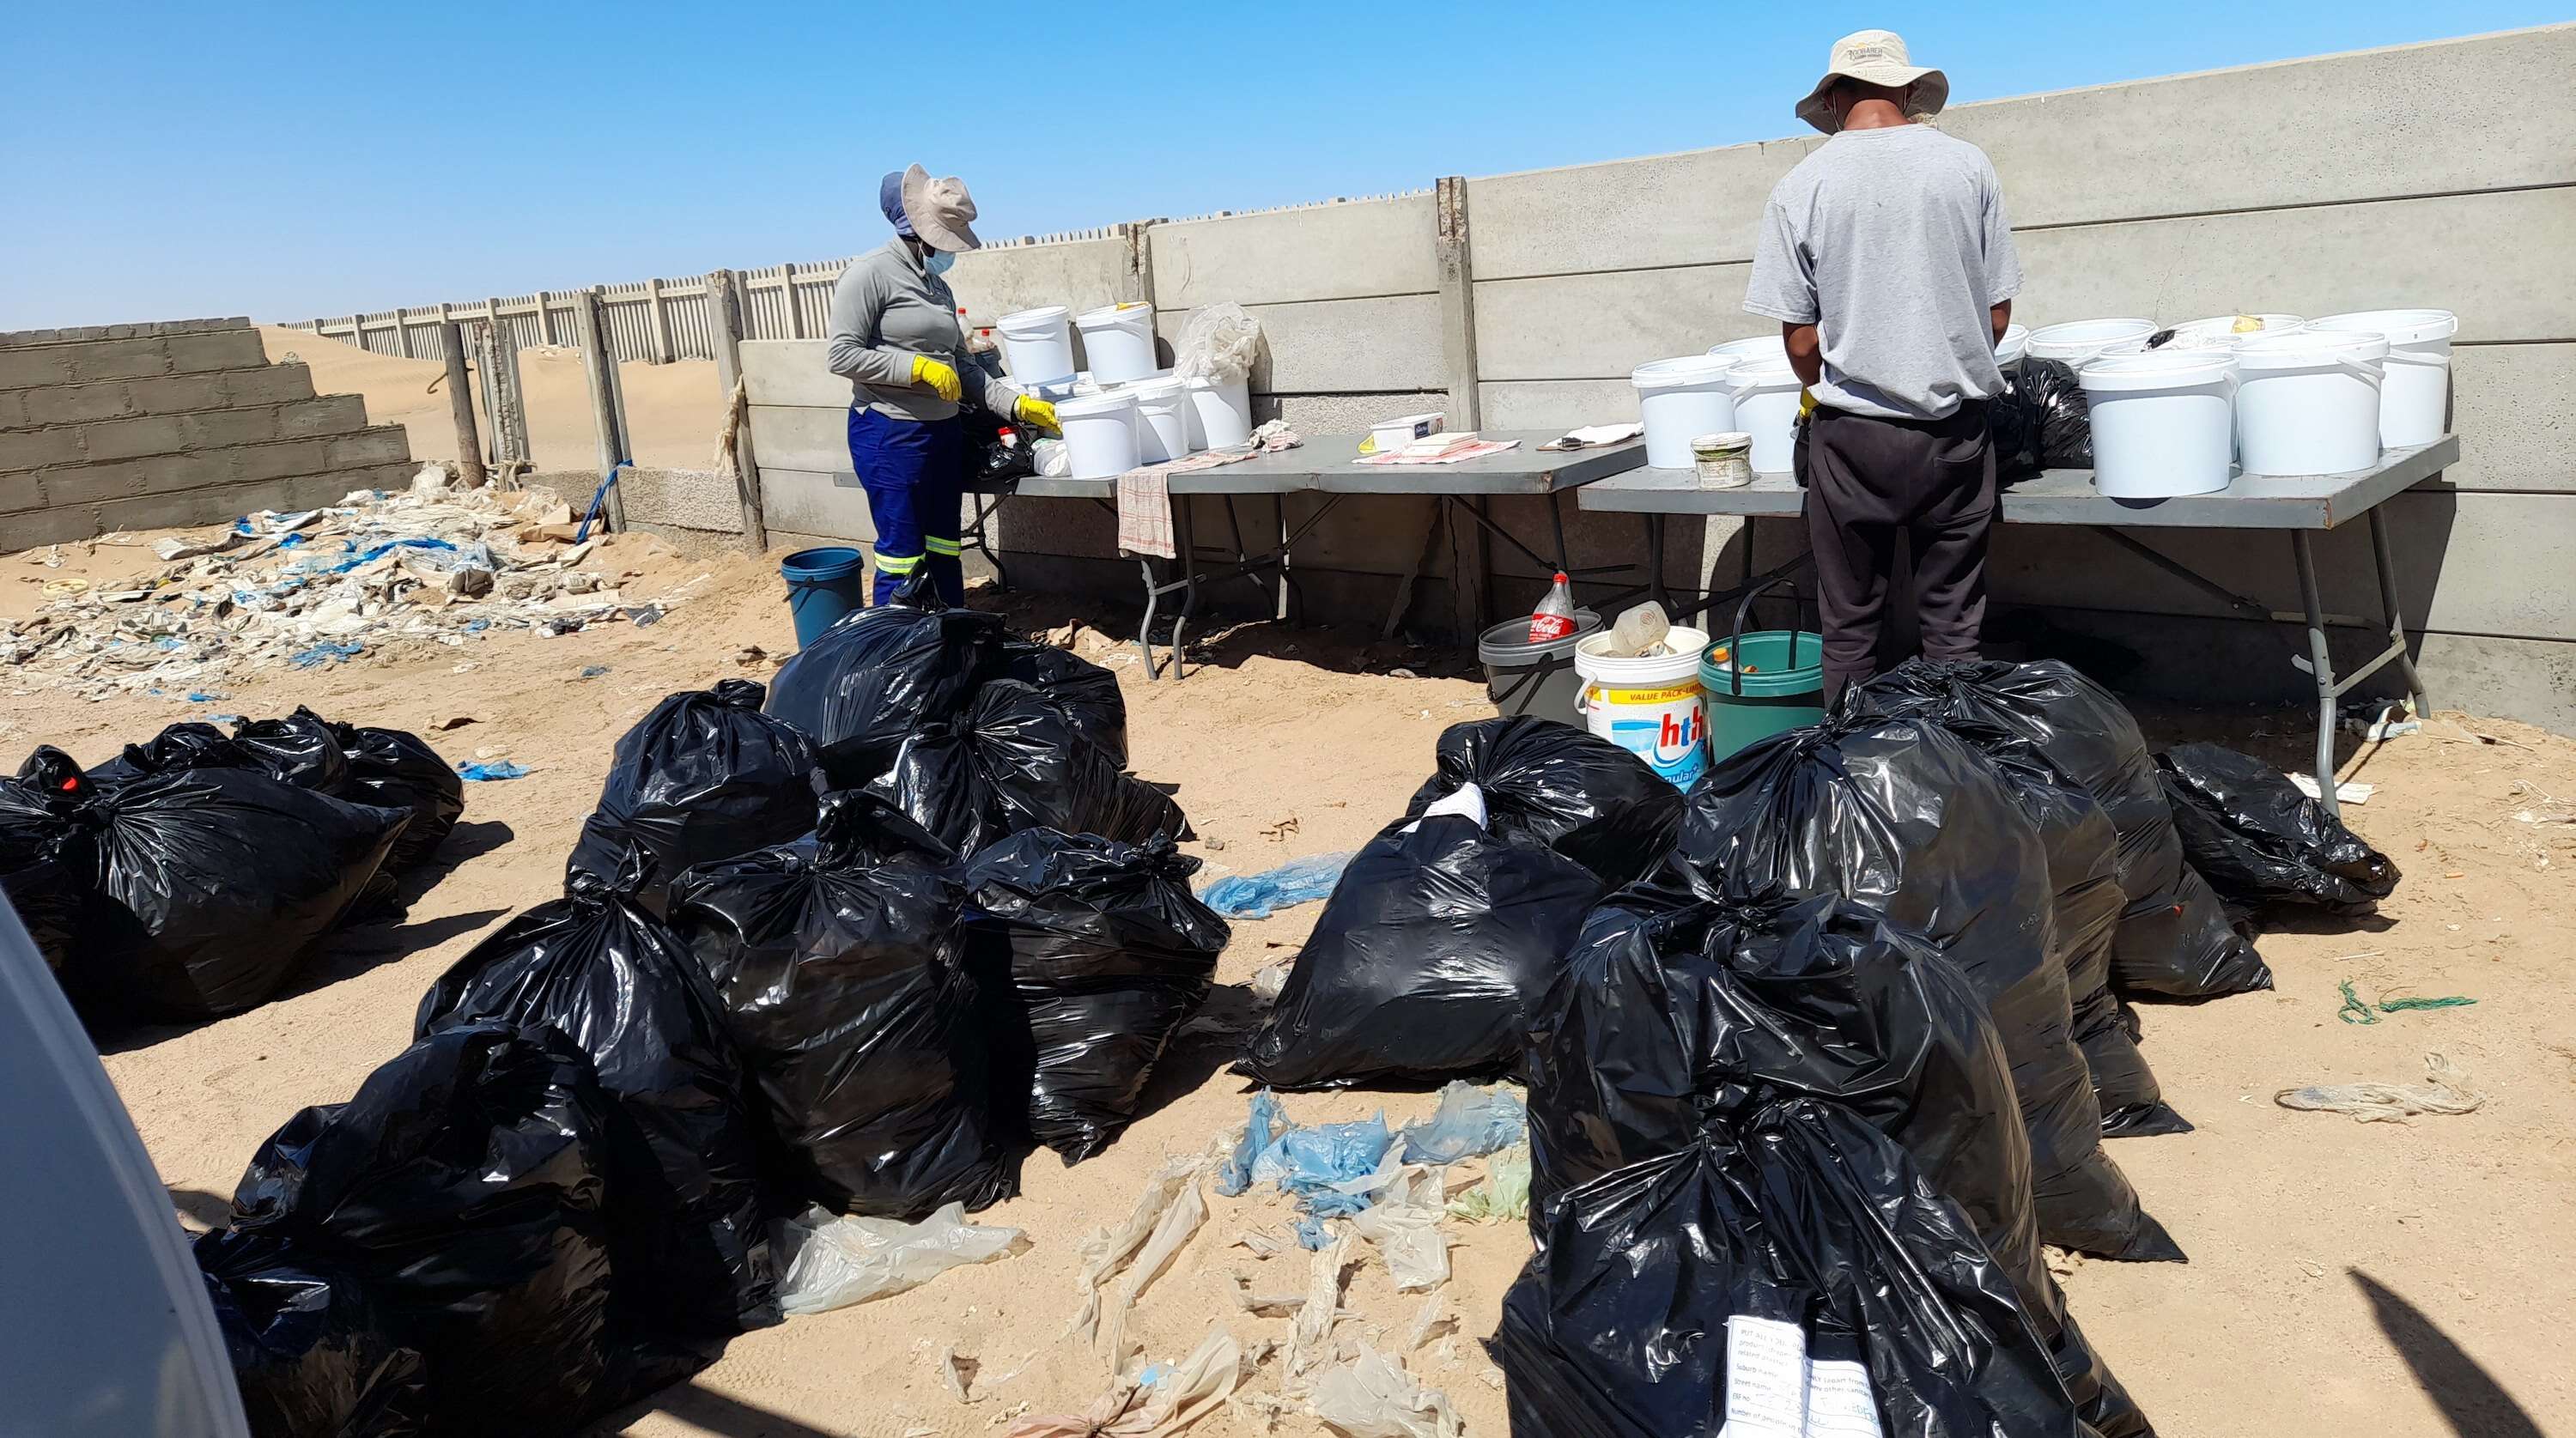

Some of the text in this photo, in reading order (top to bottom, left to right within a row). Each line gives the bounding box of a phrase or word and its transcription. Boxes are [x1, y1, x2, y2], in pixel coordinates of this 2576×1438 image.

[1630, 692, 1658, 701] VALUE
[1661, 706, 1704, 747] hth
[1731, 1407, 1752, 1417] Number
